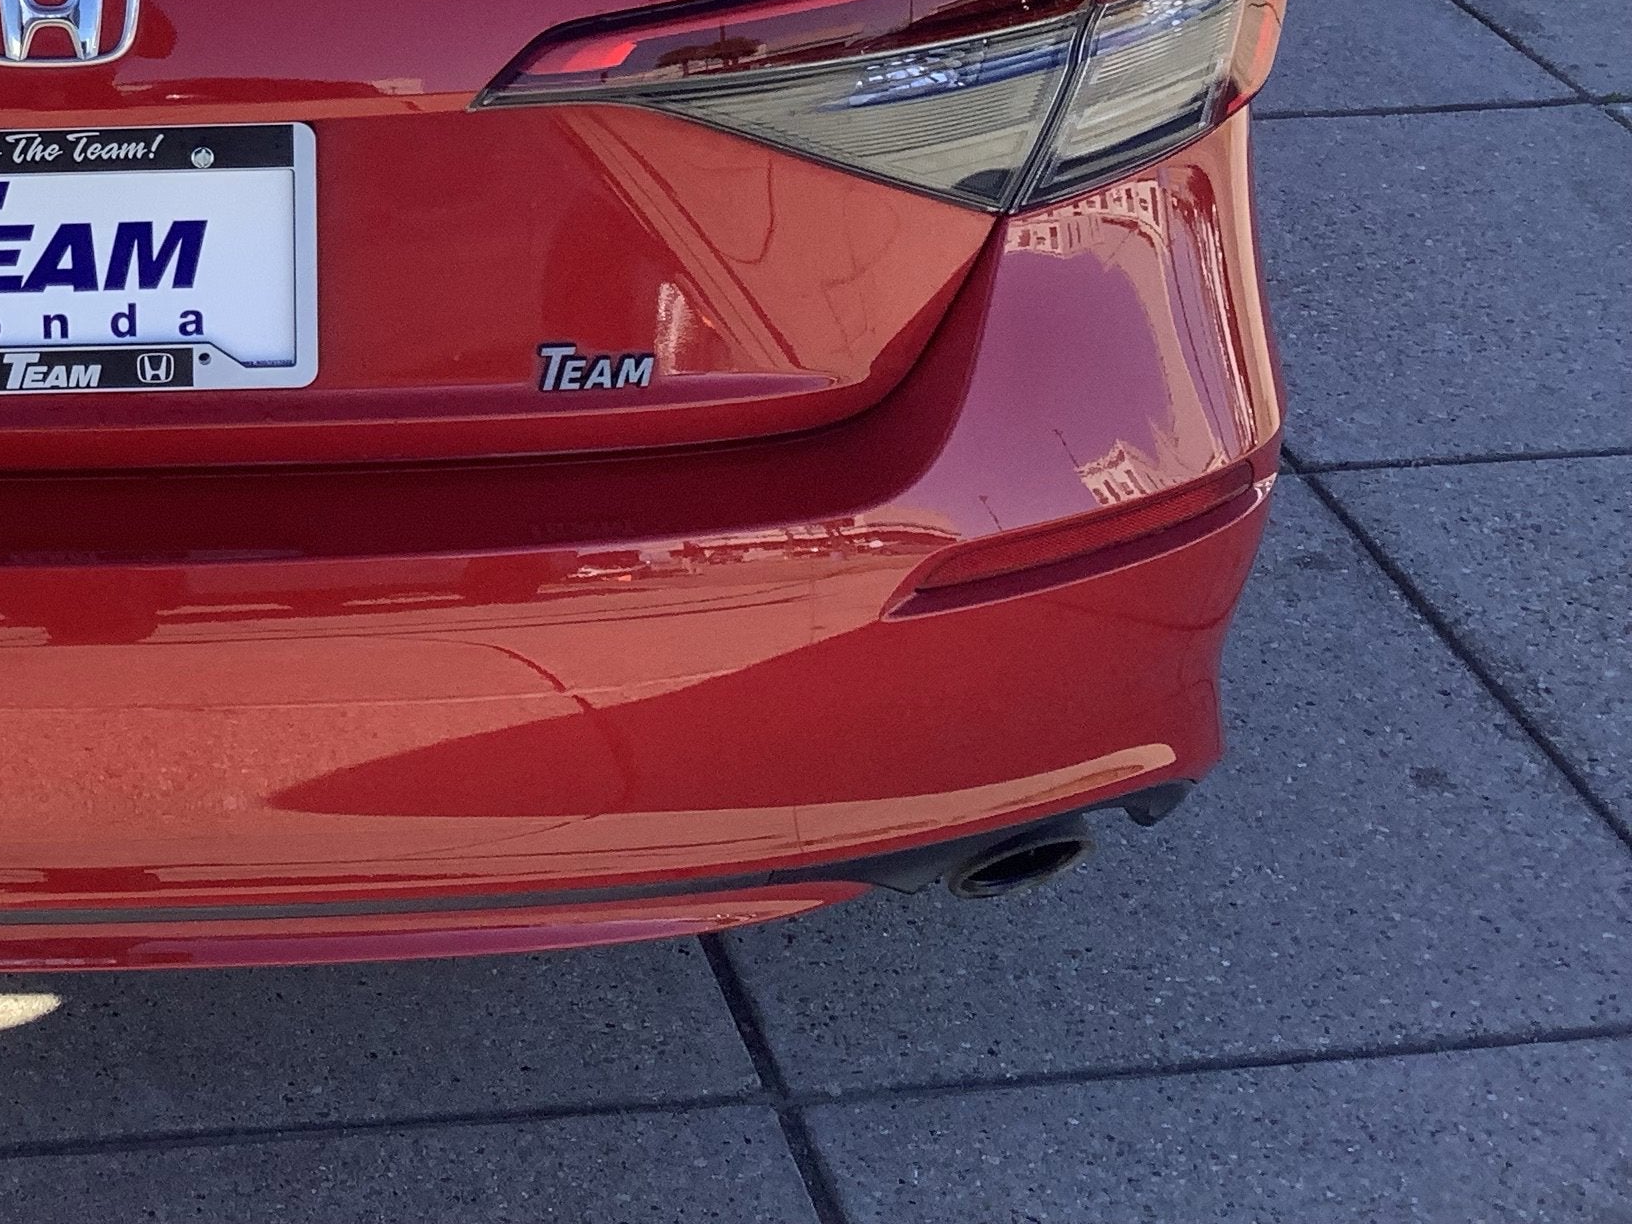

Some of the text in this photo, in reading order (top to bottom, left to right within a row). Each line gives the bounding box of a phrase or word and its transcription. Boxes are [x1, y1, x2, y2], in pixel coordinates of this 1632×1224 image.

[5, 134, 63, 163] The
[67, 133, 165, 162] Team!
[2, 352, 102, 390] TEAM
[539, 345, 655, 392] TEAM
